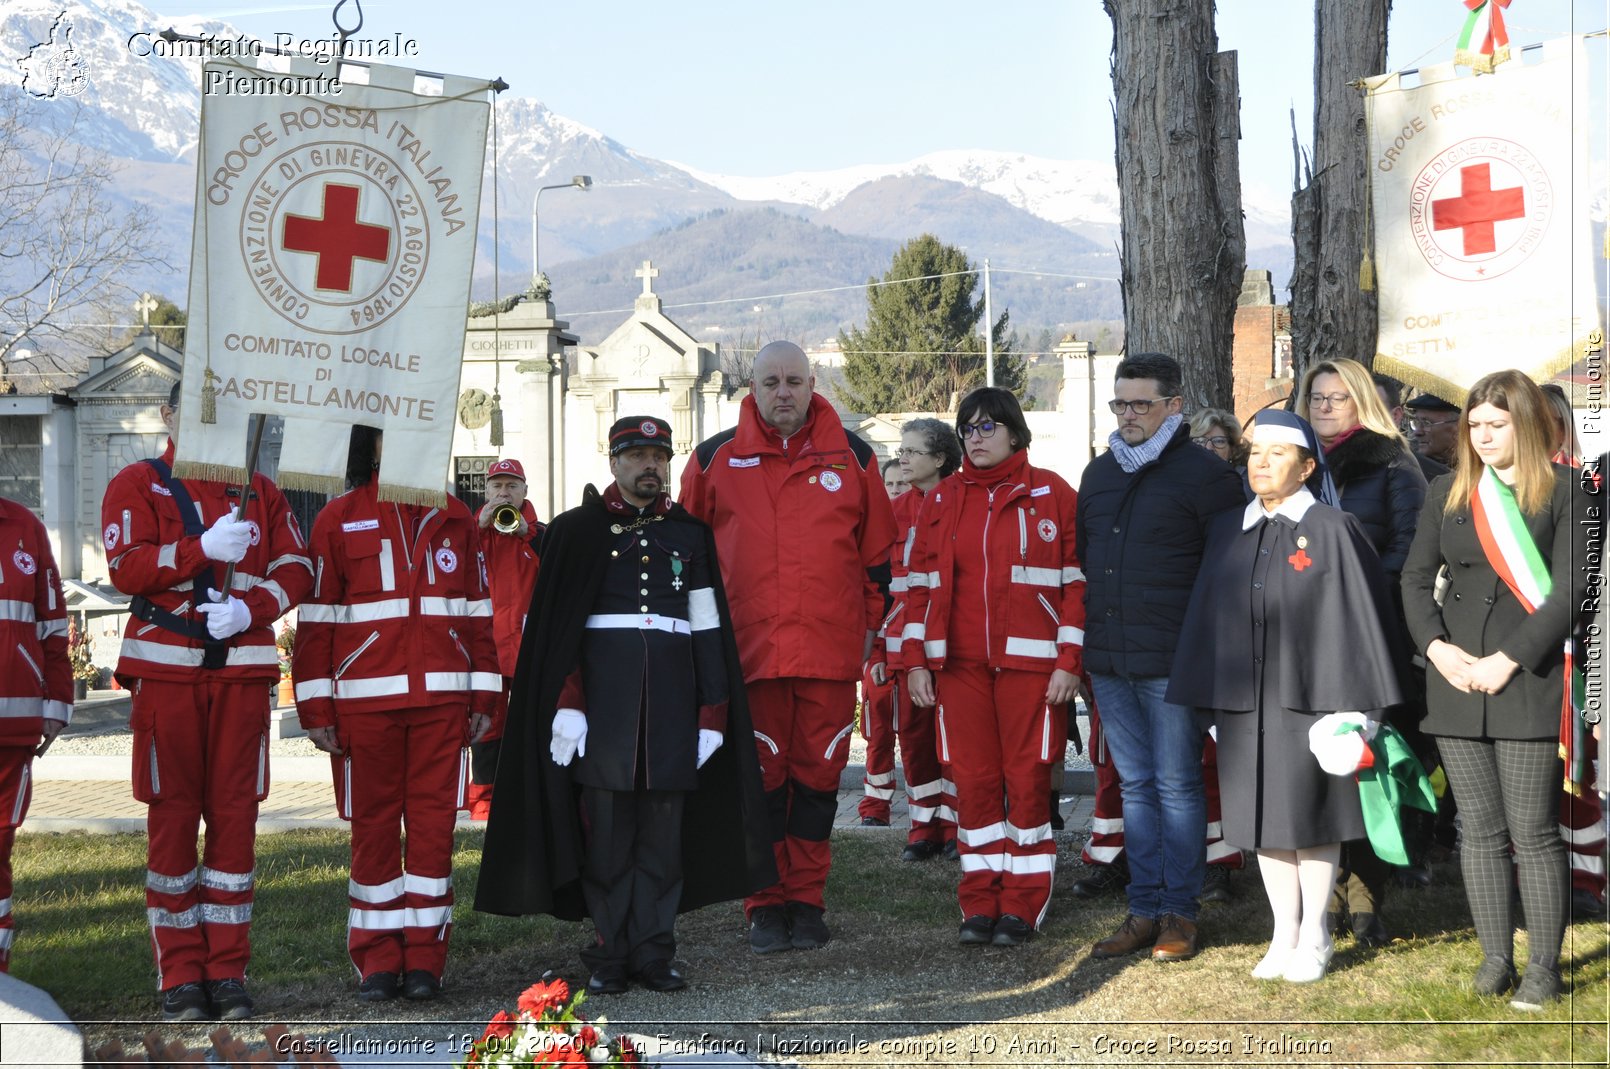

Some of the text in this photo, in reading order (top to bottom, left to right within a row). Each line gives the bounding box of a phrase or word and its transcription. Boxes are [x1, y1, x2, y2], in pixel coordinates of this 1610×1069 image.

[208, 106, 466, 237] CROCE ROSSA ITALIANA
[1378, 116, 1426, 172] CROCE
[248, 148, 424, 327] CONVENZIONE DI GINEVRA 22 AGOSTO 1864
[1413, 171, 1443, 267] CONVENZIONE
[1432, 157, 1447, 174] DI
[1448, 143, 1508, 164] GINEVRA
[225, 333, 421, 373] COMITATO LOCALE
[315, 367, 332, 382] DI
